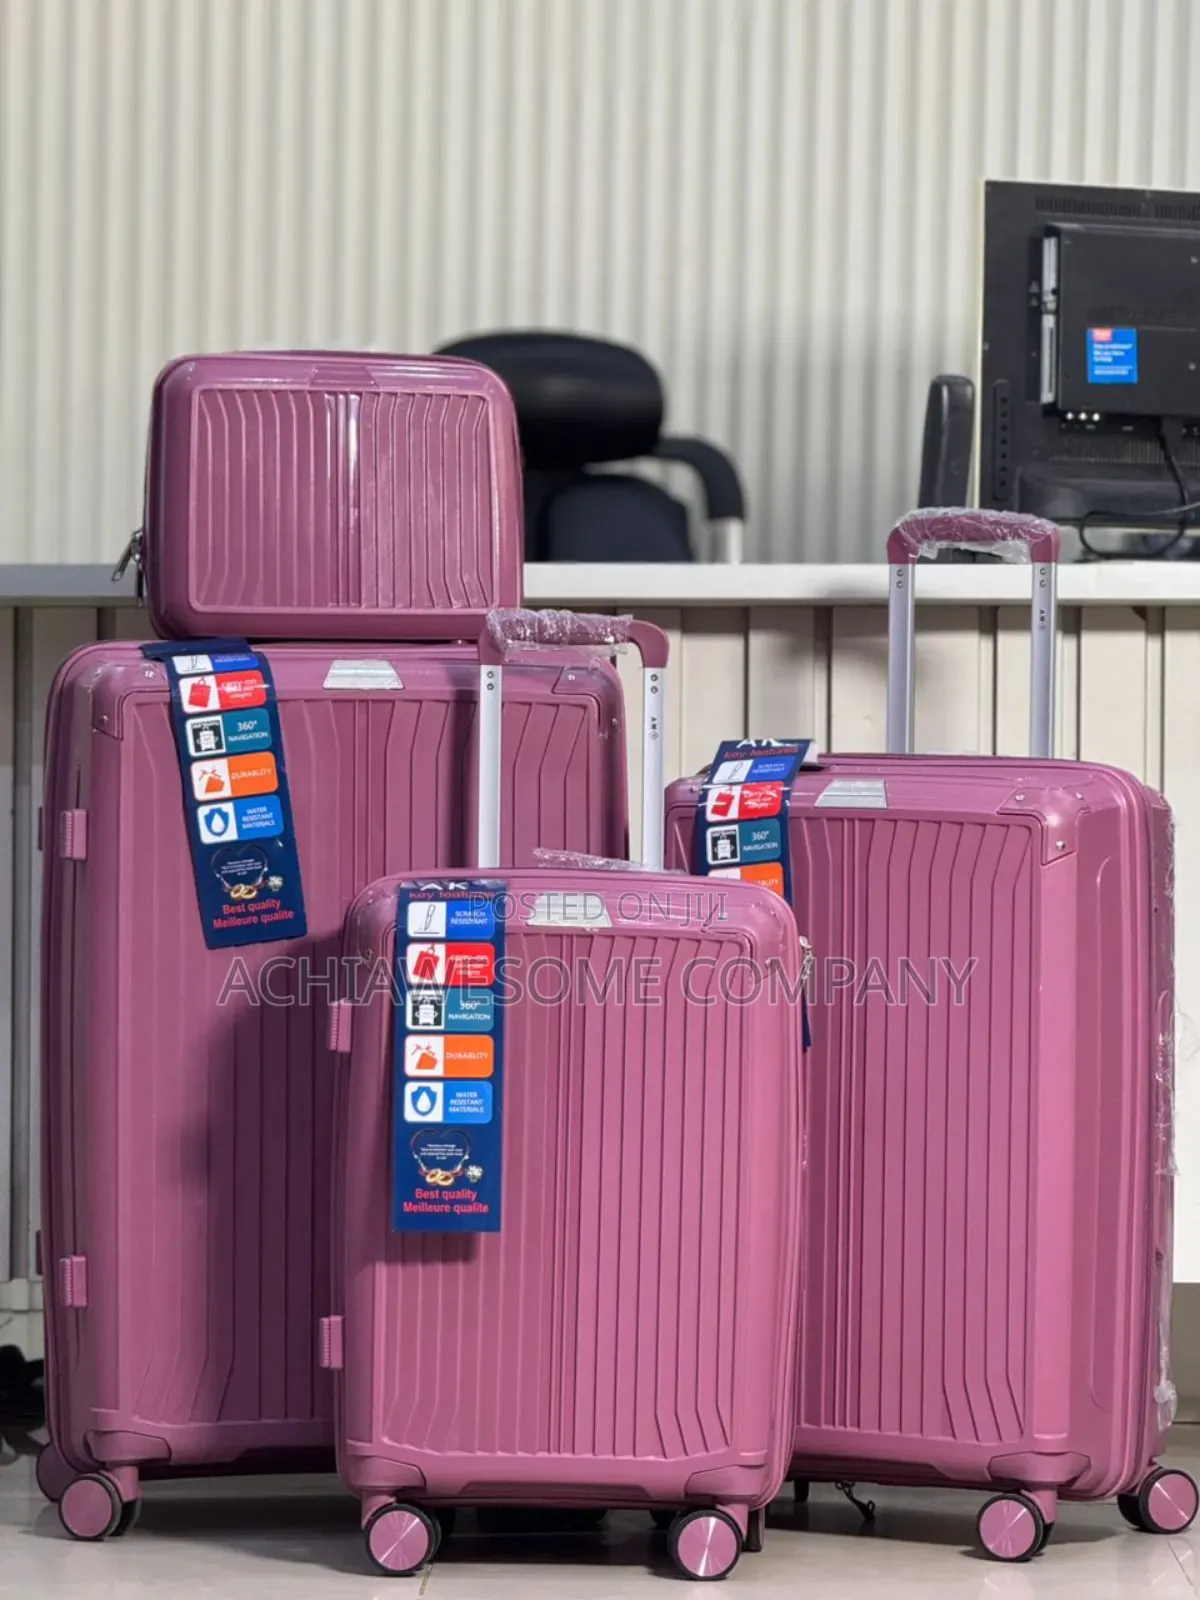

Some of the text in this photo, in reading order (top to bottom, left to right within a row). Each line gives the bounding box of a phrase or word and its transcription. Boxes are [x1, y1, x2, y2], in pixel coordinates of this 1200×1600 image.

[227, 731, 269, 742] NAVIGATION
[246, 806, 268, 815] WATER
[241, 812, 274, 822] RESISTANT
[242, 820, 276, 830] MATERIALS
[223, 899, 281, 914] Best quality
[214, 909, 295, 930] Meilleure qualite
[449, 1106, 485, 1114] MATERIALS
[415, 1188, 477, 1201] Best quality
[403, 1202, 489, 1215] Meilleure qualite
